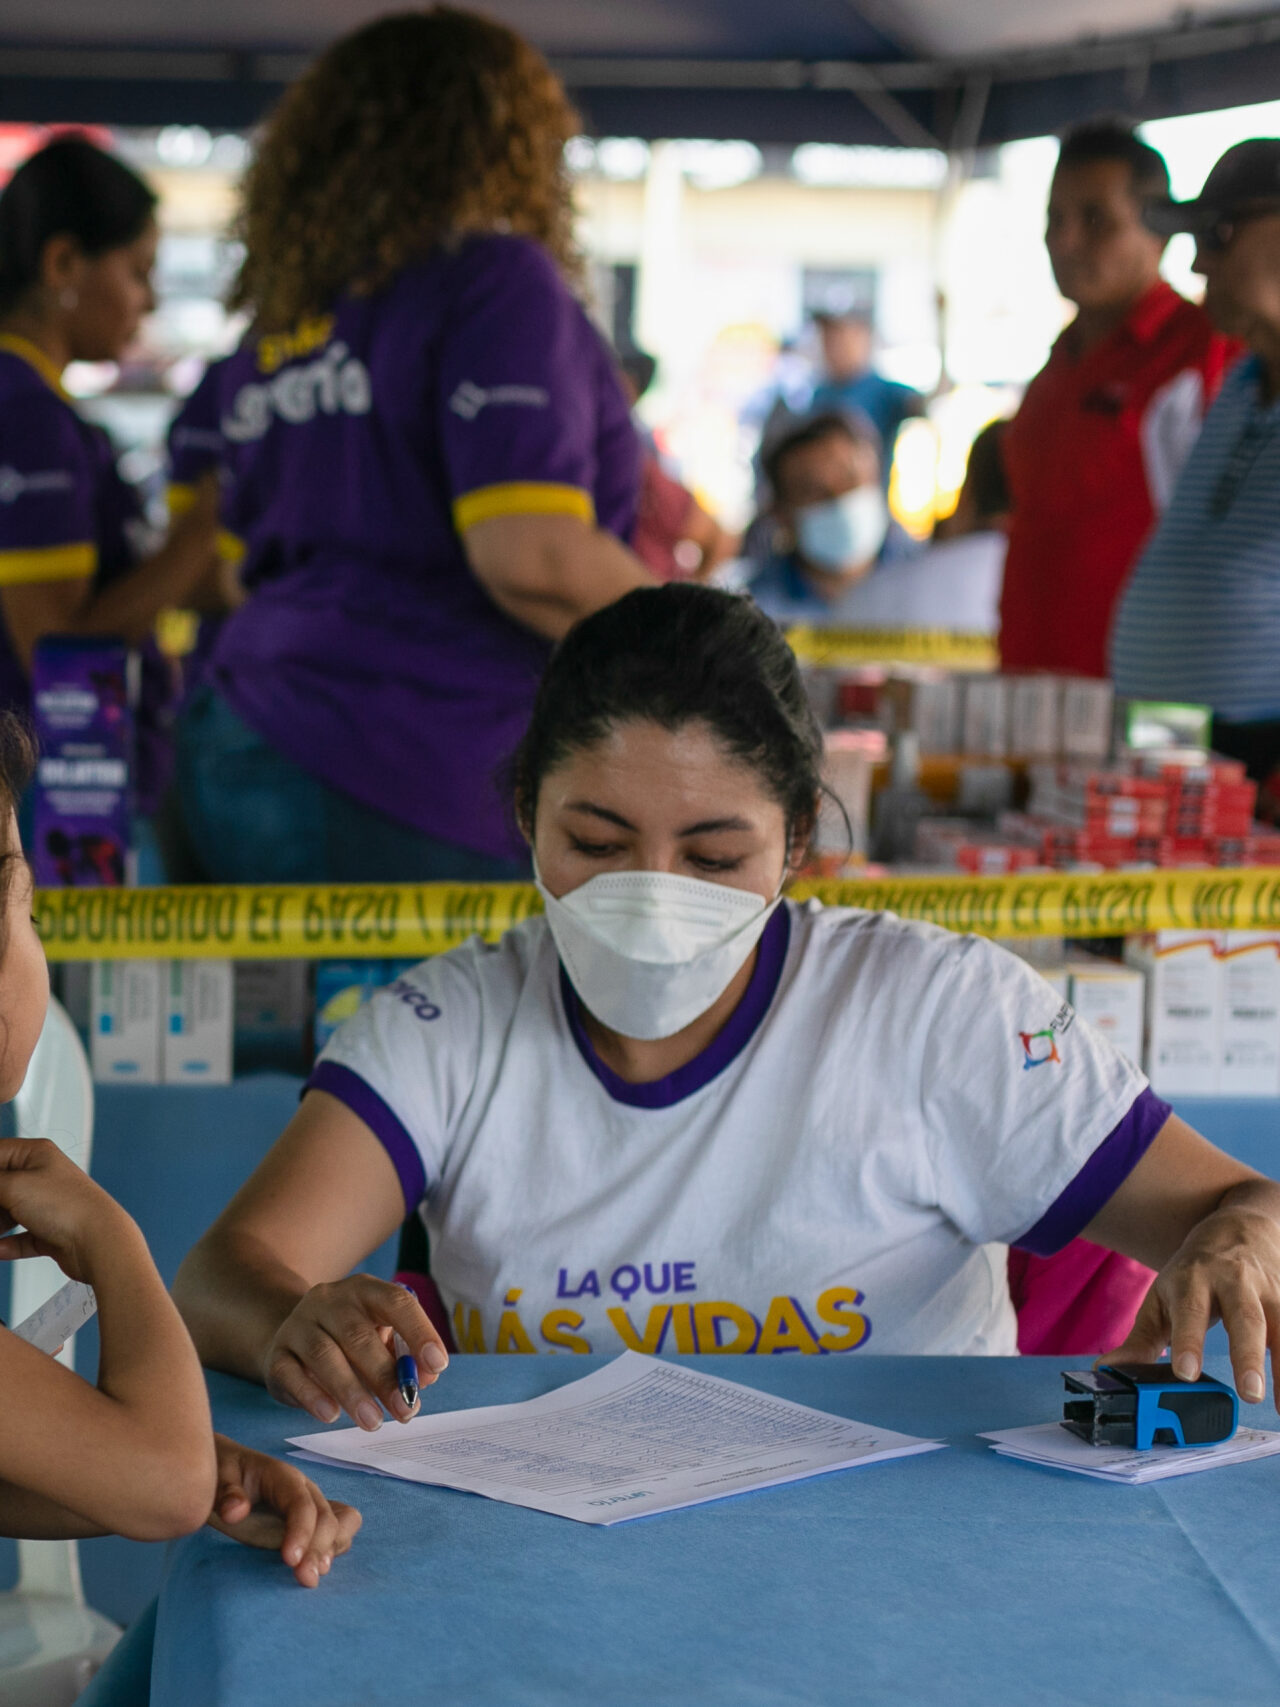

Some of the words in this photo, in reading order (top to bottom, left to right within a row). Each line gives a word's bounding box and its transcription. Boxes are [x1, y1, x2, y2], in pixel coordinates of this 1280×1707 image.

[556, 1267, 601, 1299] LA
[610, 1261, 697, 1302] QUE
[606, 1286, 872, 1356] VIDAS
